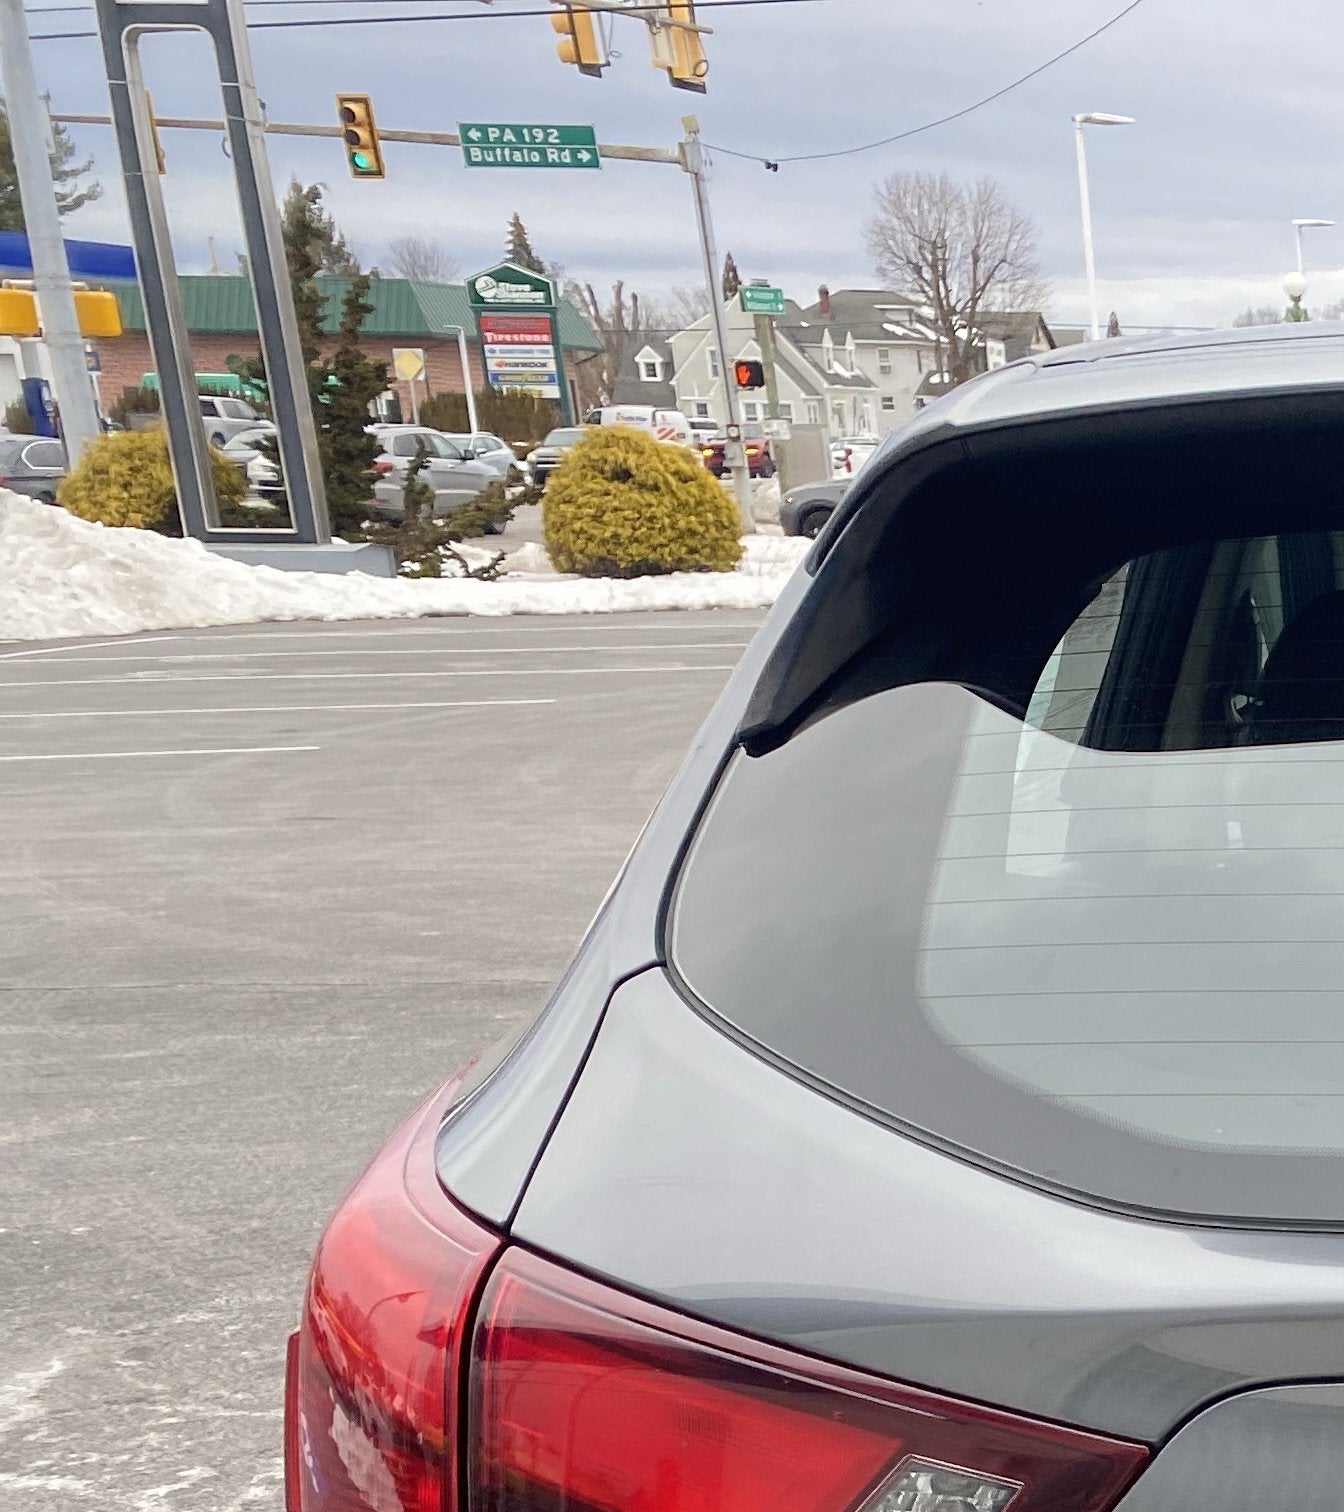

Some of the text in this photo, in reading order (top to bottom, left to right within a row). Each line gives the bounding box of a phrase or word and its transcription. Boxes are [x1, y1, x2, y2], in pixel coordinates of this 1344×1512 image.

[487, 127, 561, 143] PA 192
[469, 147, 572, 163] Buffalo Rd
